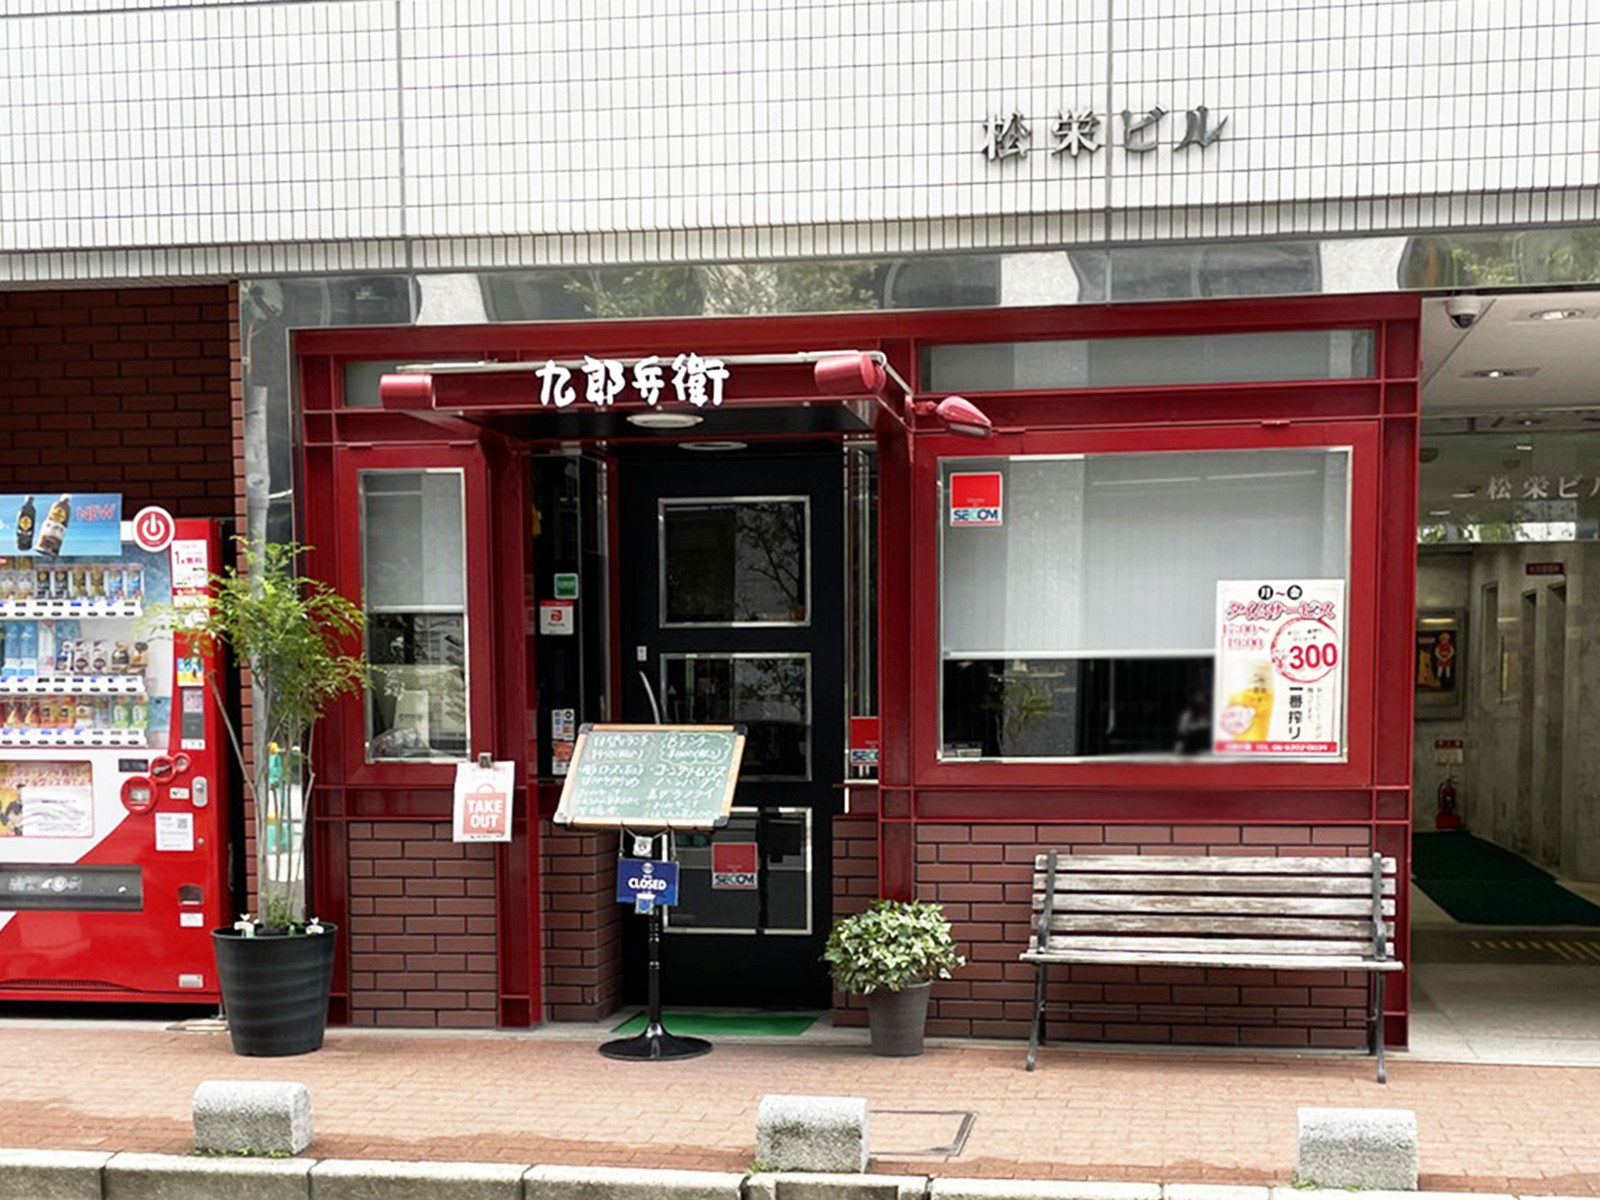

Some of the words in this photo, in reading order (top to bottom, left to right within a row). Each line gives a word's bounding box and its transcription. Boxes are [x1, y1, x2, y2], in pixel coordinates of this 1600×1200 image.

[982, 105, 1228, 161] 松栄ビル
[535, 352, 730, 407] 九郎兵衛
[76, 505, 116, 521] NEW
[953, 508, 999, 521] SECOM
[1288, 686, 1304, 740] 一番搾り
[466, 799, 504, 814] TAKE
[469, 813, 499, 829] OUT
[627, 877, 667, 891] CLOSED
[714, 872, 755, 885] SECOM
